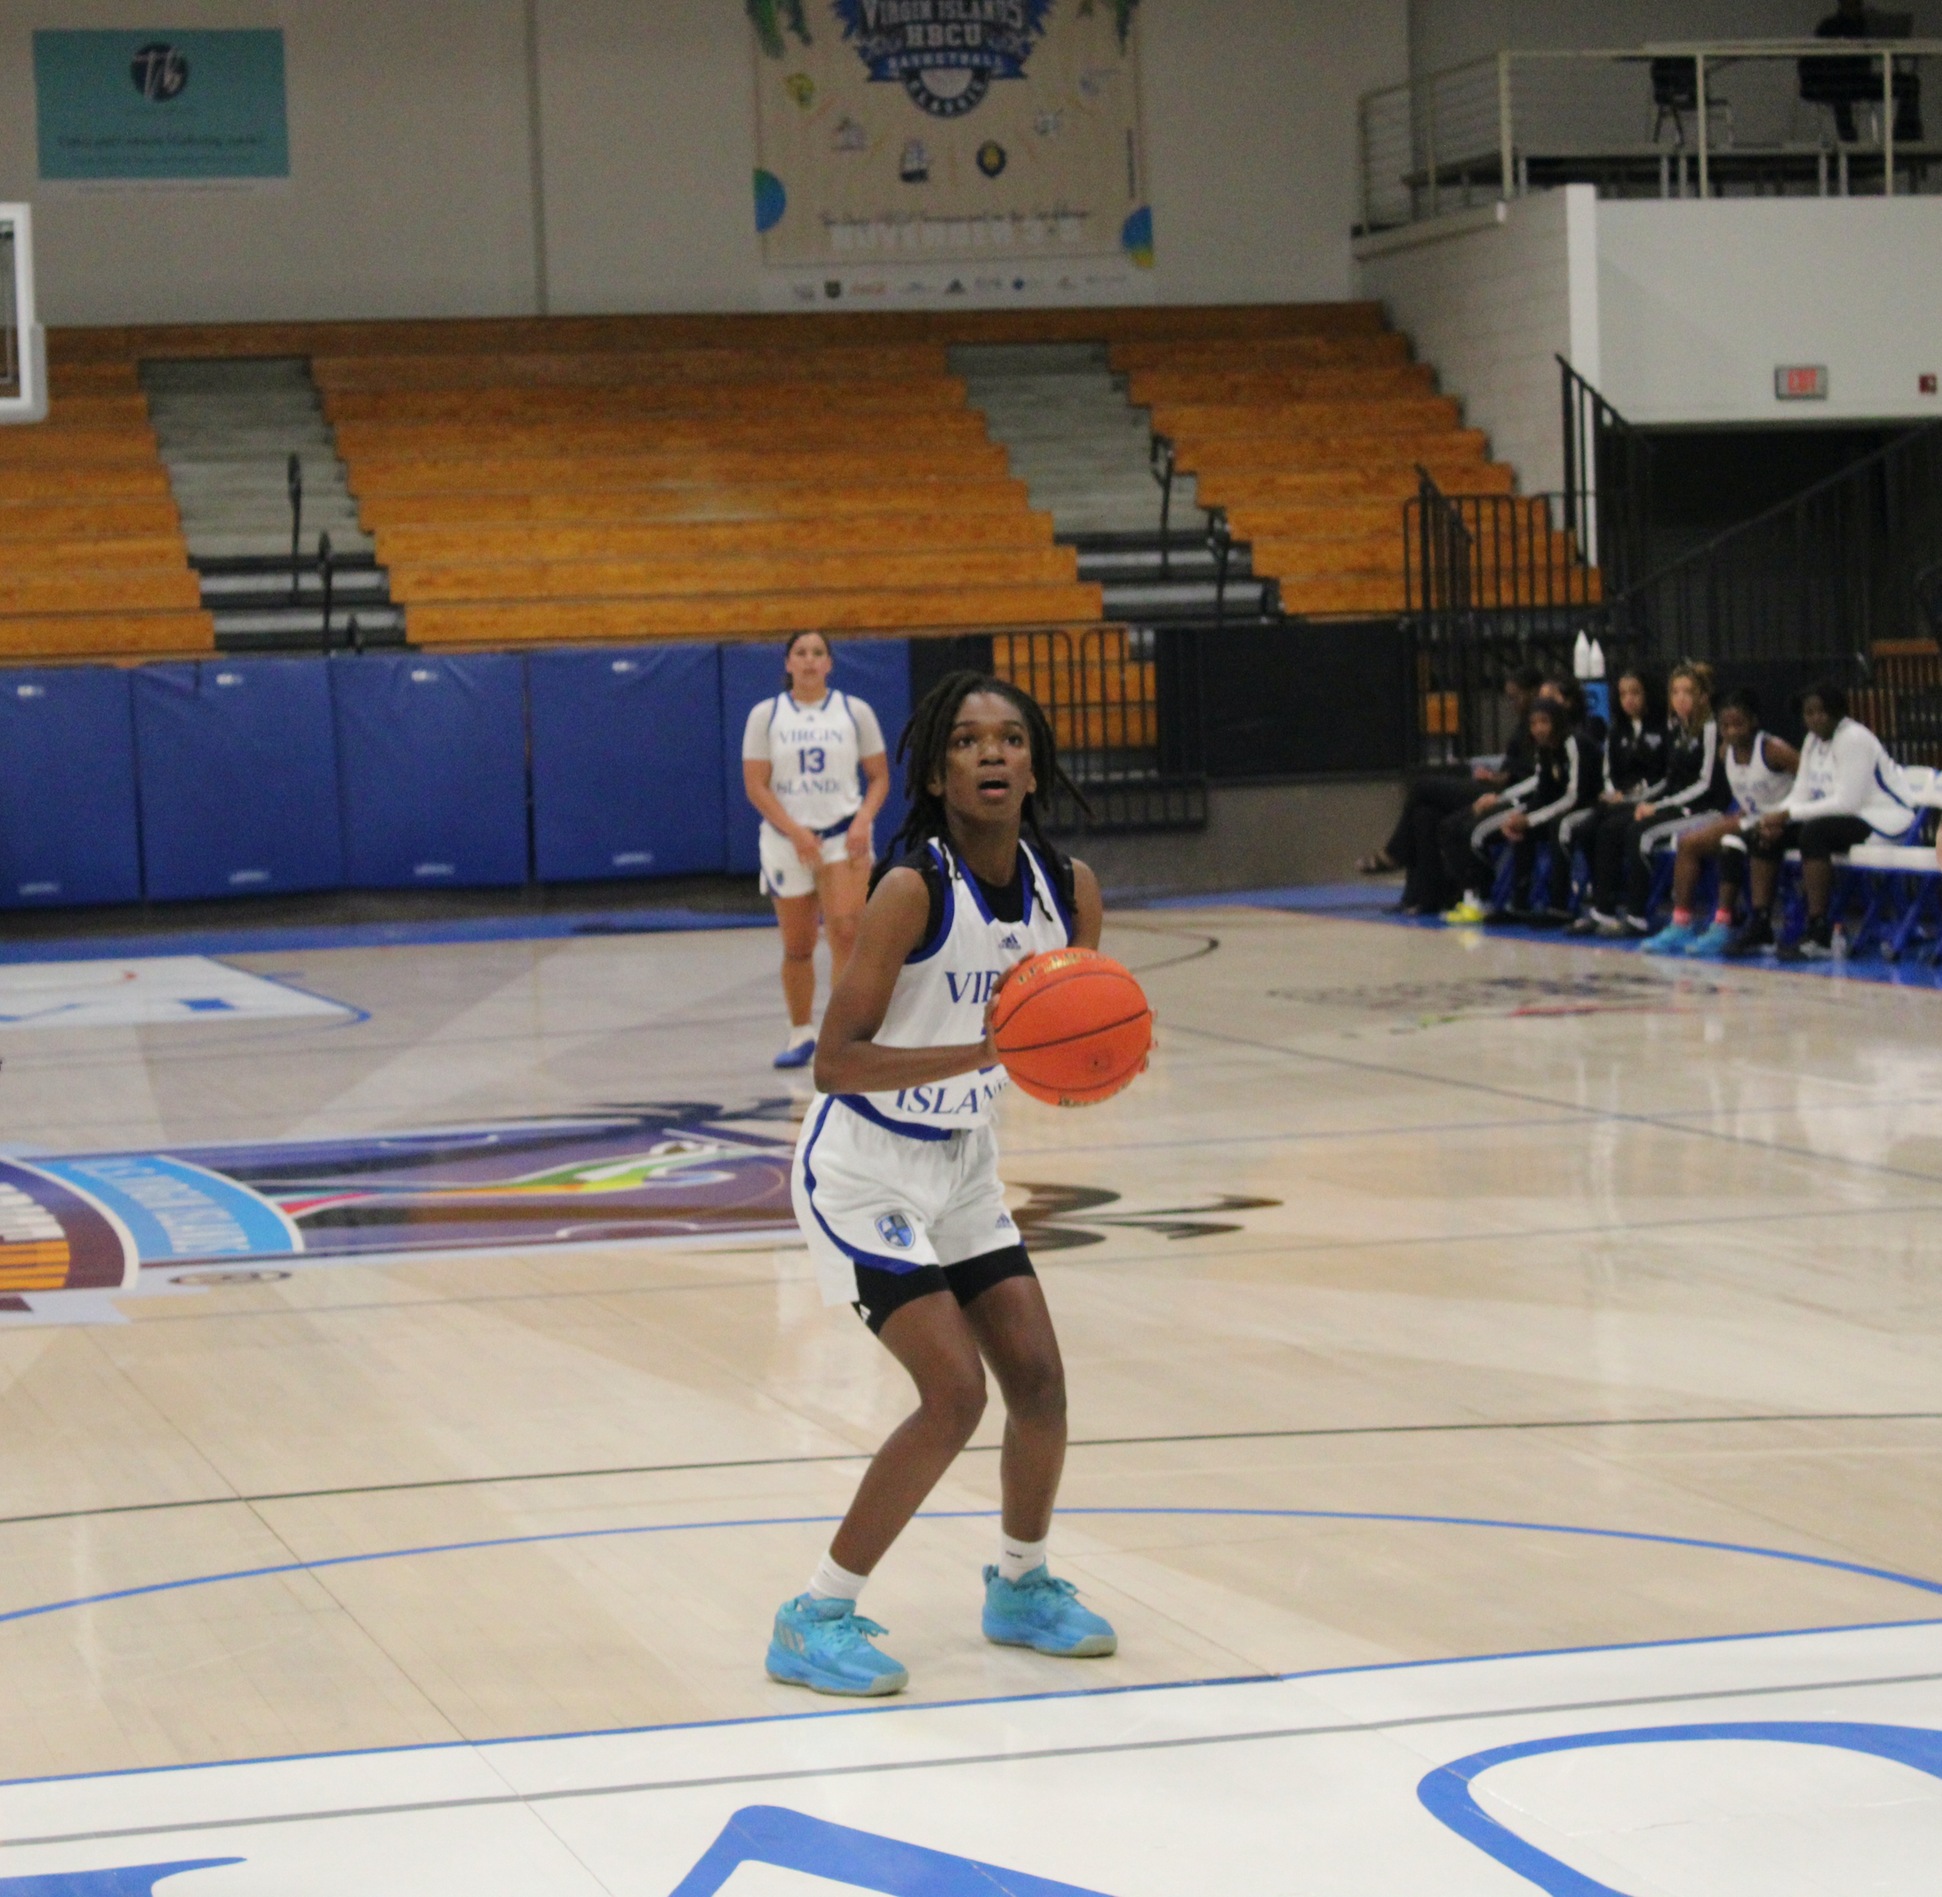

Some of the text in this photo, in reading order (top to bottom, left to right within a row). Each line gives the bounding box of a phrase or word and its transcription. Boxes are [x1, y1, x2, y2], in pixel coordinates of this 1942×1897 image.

[905, 23, 981, 48] HBCU
[887, 51, 1004, 70] BASKETBALL
[779, 729, 844, 743] VIRGIN
[798, 747, 826, 774] 13
[945, 970, 1001, 1004] VIR
